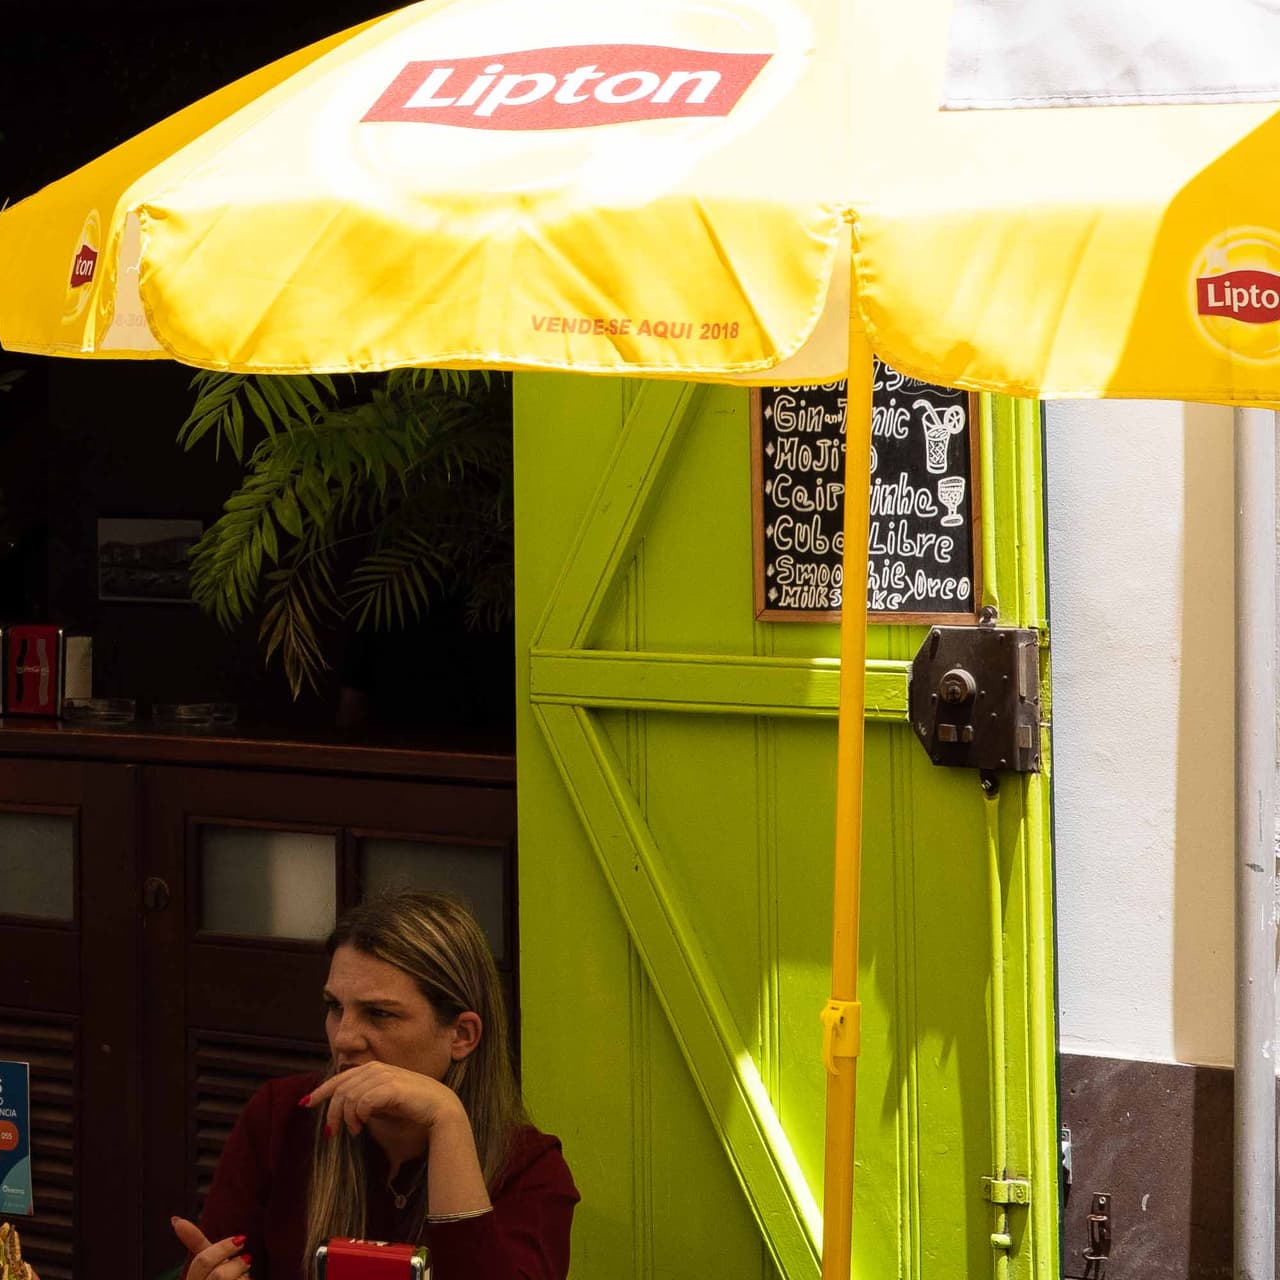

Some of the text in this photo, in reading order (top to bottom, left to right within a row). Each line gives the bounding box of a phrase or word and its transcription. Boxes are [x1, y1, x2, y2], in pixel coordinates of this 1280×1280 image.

[403, 63, 722, 118] Lipton
[531, 314, 739, 340] VENDE-SE AQUI 2018
[773, 395, 824, 432] Gin
[869, 519, 954, 563] Libre
[914, 569, 971, 600] Oreo
